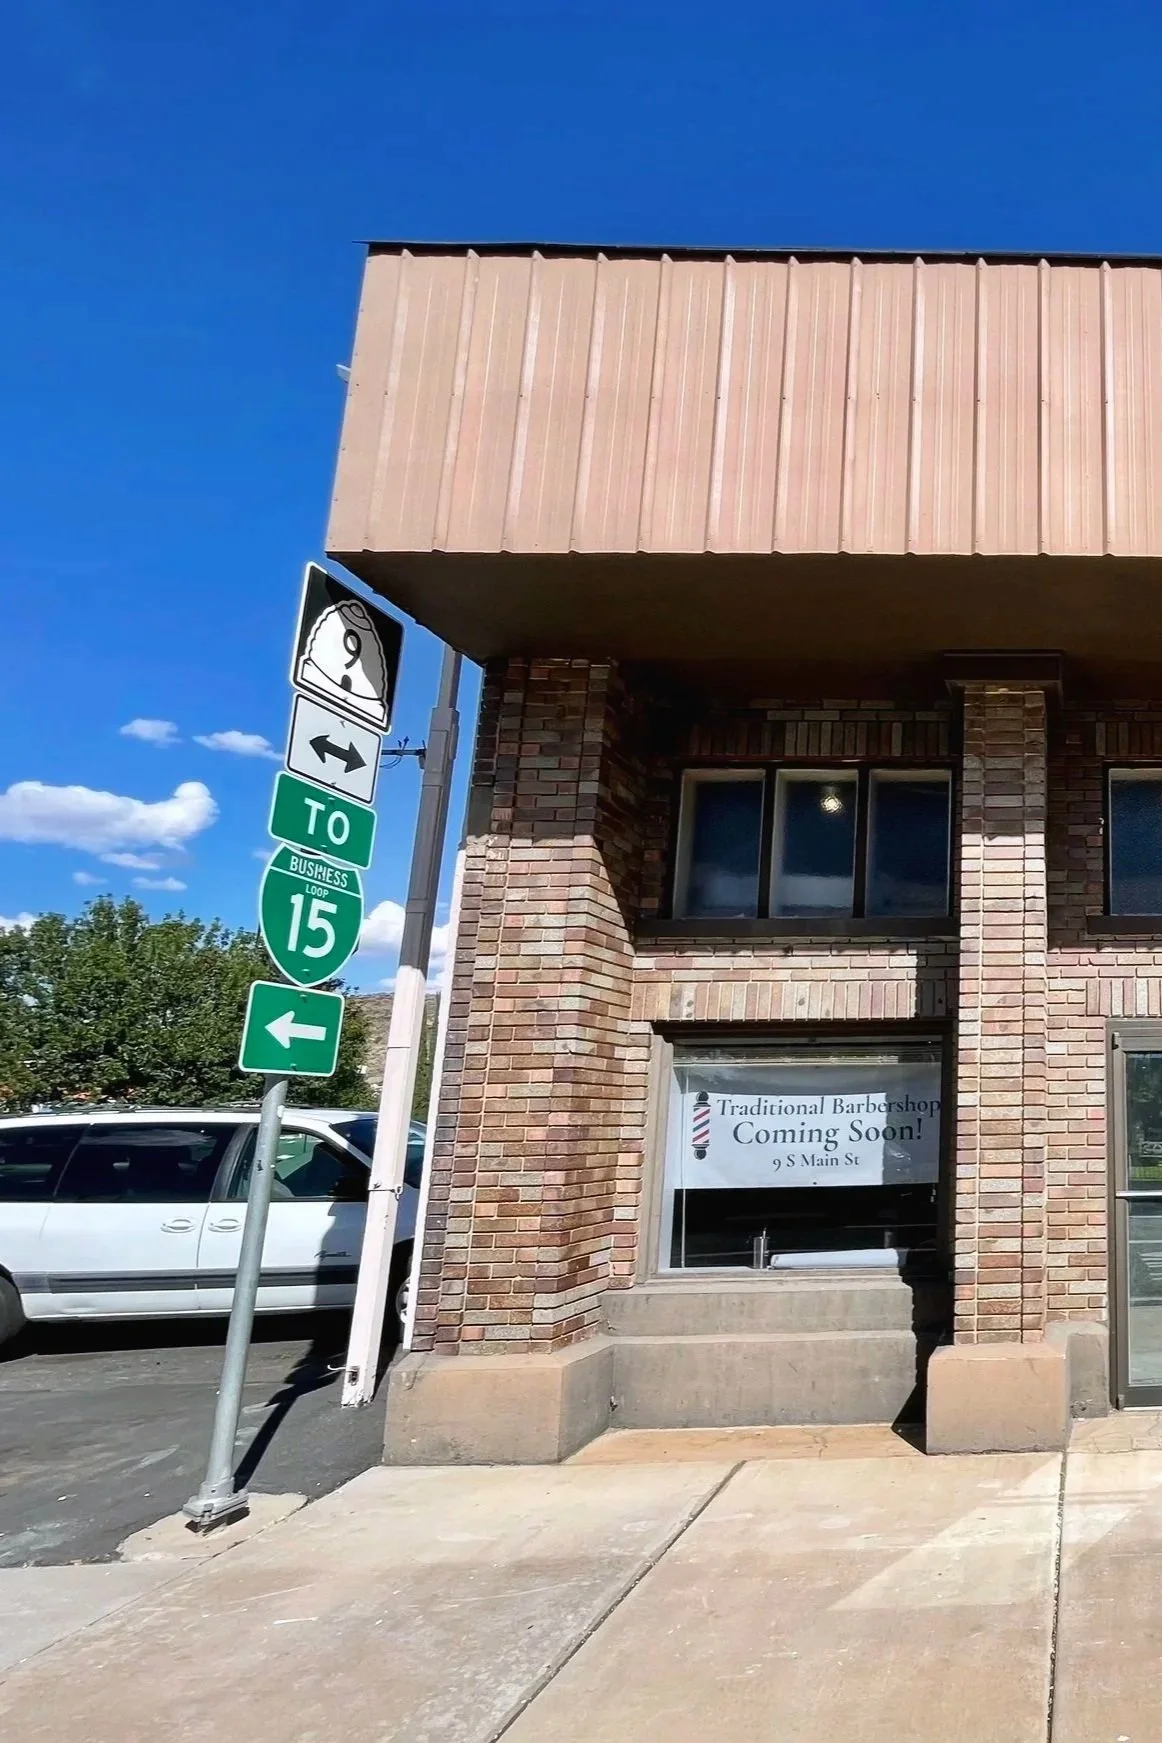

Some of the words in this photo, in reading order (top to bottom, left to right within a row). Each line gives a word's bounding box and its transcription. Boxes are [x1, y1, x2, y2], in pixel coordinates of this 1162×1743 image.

[343, 628, 362, 670] 9
[304, 797, 350, 846] TO
[289, 855, 349, 888] BUSINESS
[305, 883, 330, 898] LOOP
[287, 893, 338, 958] 15
[716, 1096, 825, 1117] Traditional
[832, 1094, 942, 1119] Barbershop
[733, 1120, 840, 1152] Coming
[848, 1118, 923, 1143] Soon!
[772, 1157, 782, 1172] 9
[786, 1153, 796, 1168] S
[800, 1153, 840, 1168] Main
[845, 1152, 860, 1167] St
